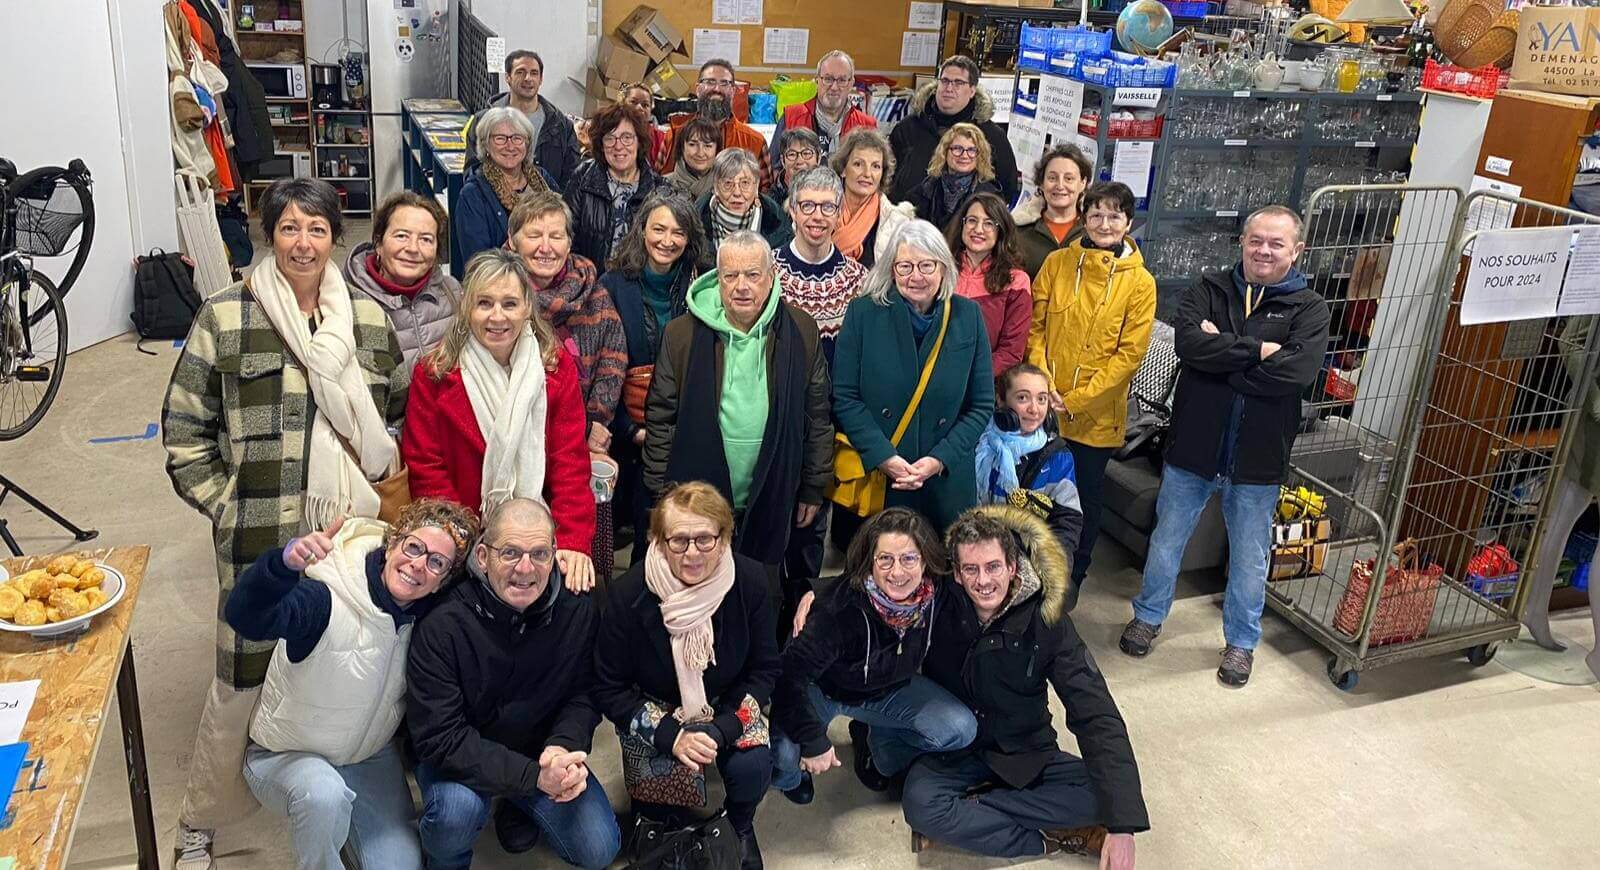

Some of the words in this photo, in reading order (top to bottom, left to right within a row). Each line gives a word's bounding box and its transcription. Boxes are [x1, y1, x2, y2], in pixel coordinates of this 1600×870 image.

[1530, 54, 1598, 64] DEMENAG
[1543, 66, 1575, 75] 44500
[1583, 67, 1595, 76] La
[1118, 92, 1158, 100] VAISSELLE
[1046, 106, 1065, 118] SONDAGE
[1479, 255, 1502, 269] NOS
[1505, 251, 1558, 267] SOUHAITS
[1484, 274, 1514, 289] POUR
[1516, 273, 1541, 288] 2024
